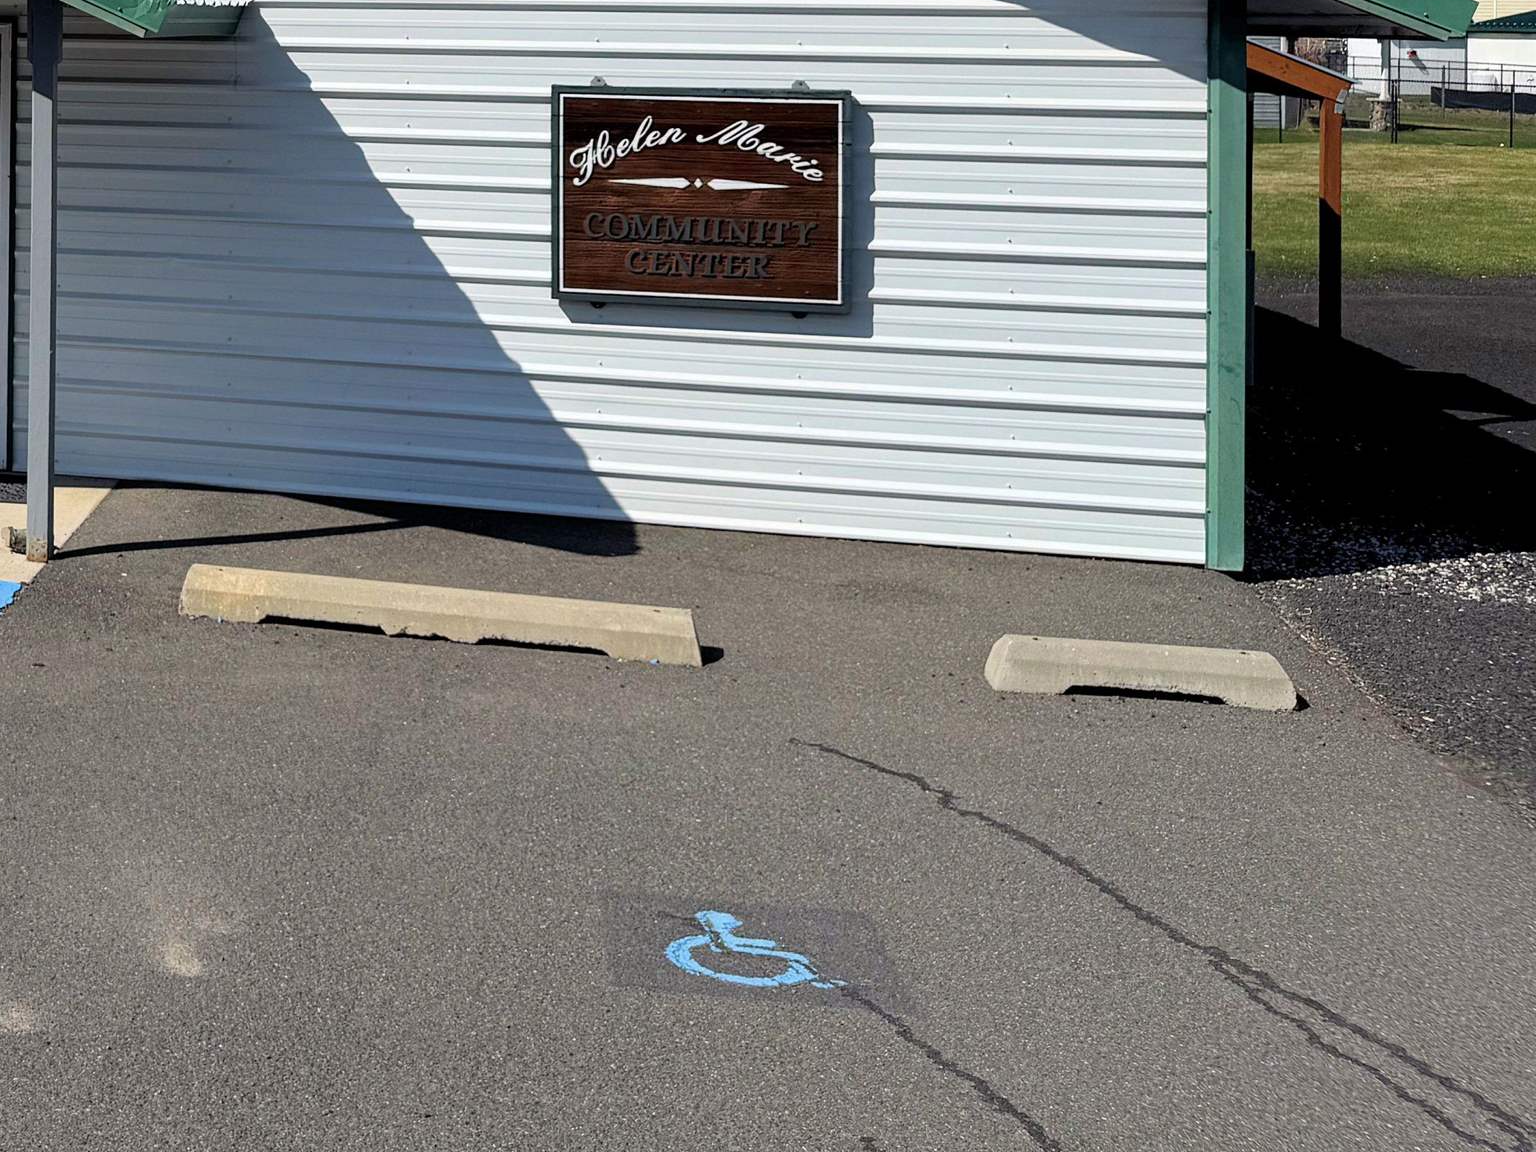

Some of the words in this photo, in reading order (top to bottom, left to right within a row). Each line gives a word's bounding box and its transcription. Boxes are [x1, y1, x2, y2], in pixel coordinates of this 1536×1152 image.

[569, 115, 688, 187] Helen
[695, 119, 824, 183] Marie
[583, 212, 817, 247] COMMUNITY
[624, 248, 775, 279] CENTER
